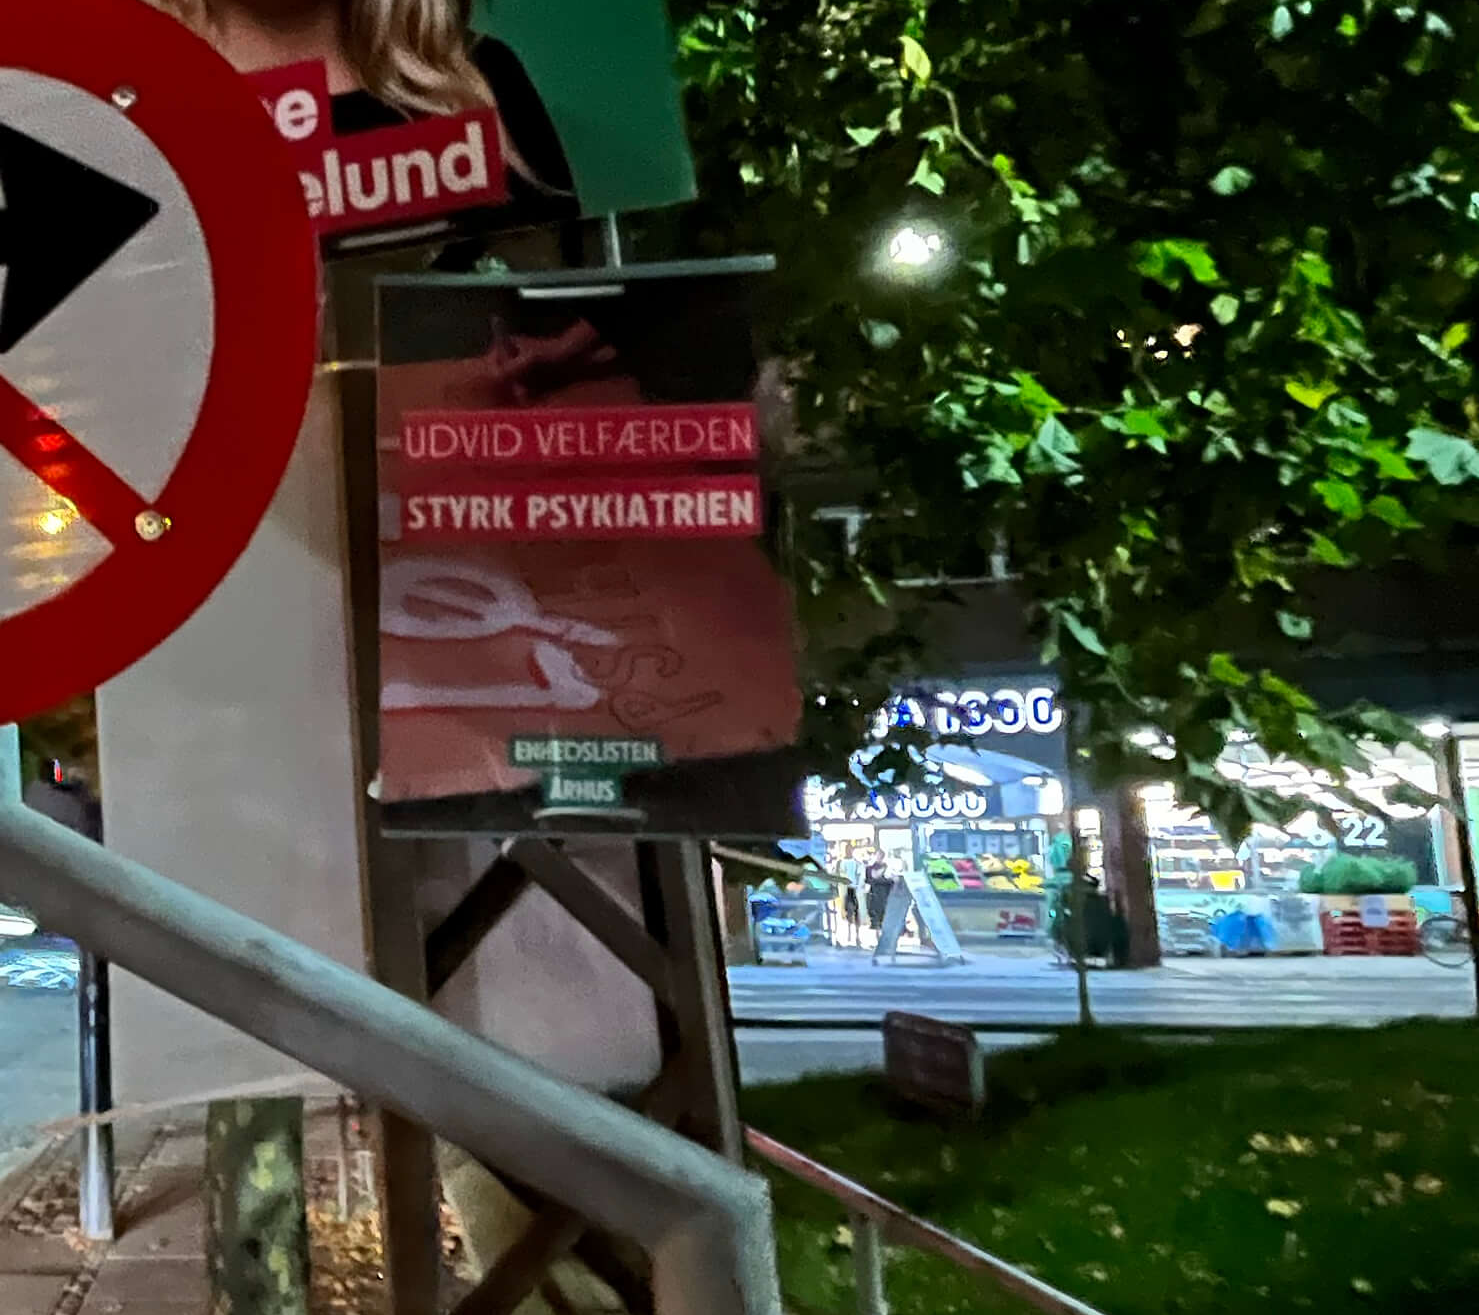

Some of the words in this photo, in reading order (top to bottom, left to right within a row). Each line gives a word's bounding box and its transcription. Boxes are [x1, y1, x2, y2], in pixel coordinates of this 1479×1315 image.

[258, 87, 319, 142] e
[405, 423, 521, 459] UDVID
[533, 417, 753, 457] VELFÆRDEN
[407, 493, 514, 530] STYRK
[526, 489, 755, 529] PSYKIATRIEN
[514, 739, 659, 764] ENHEDSLISTEN
[550, 767, 616, 802] ÅRHUS
